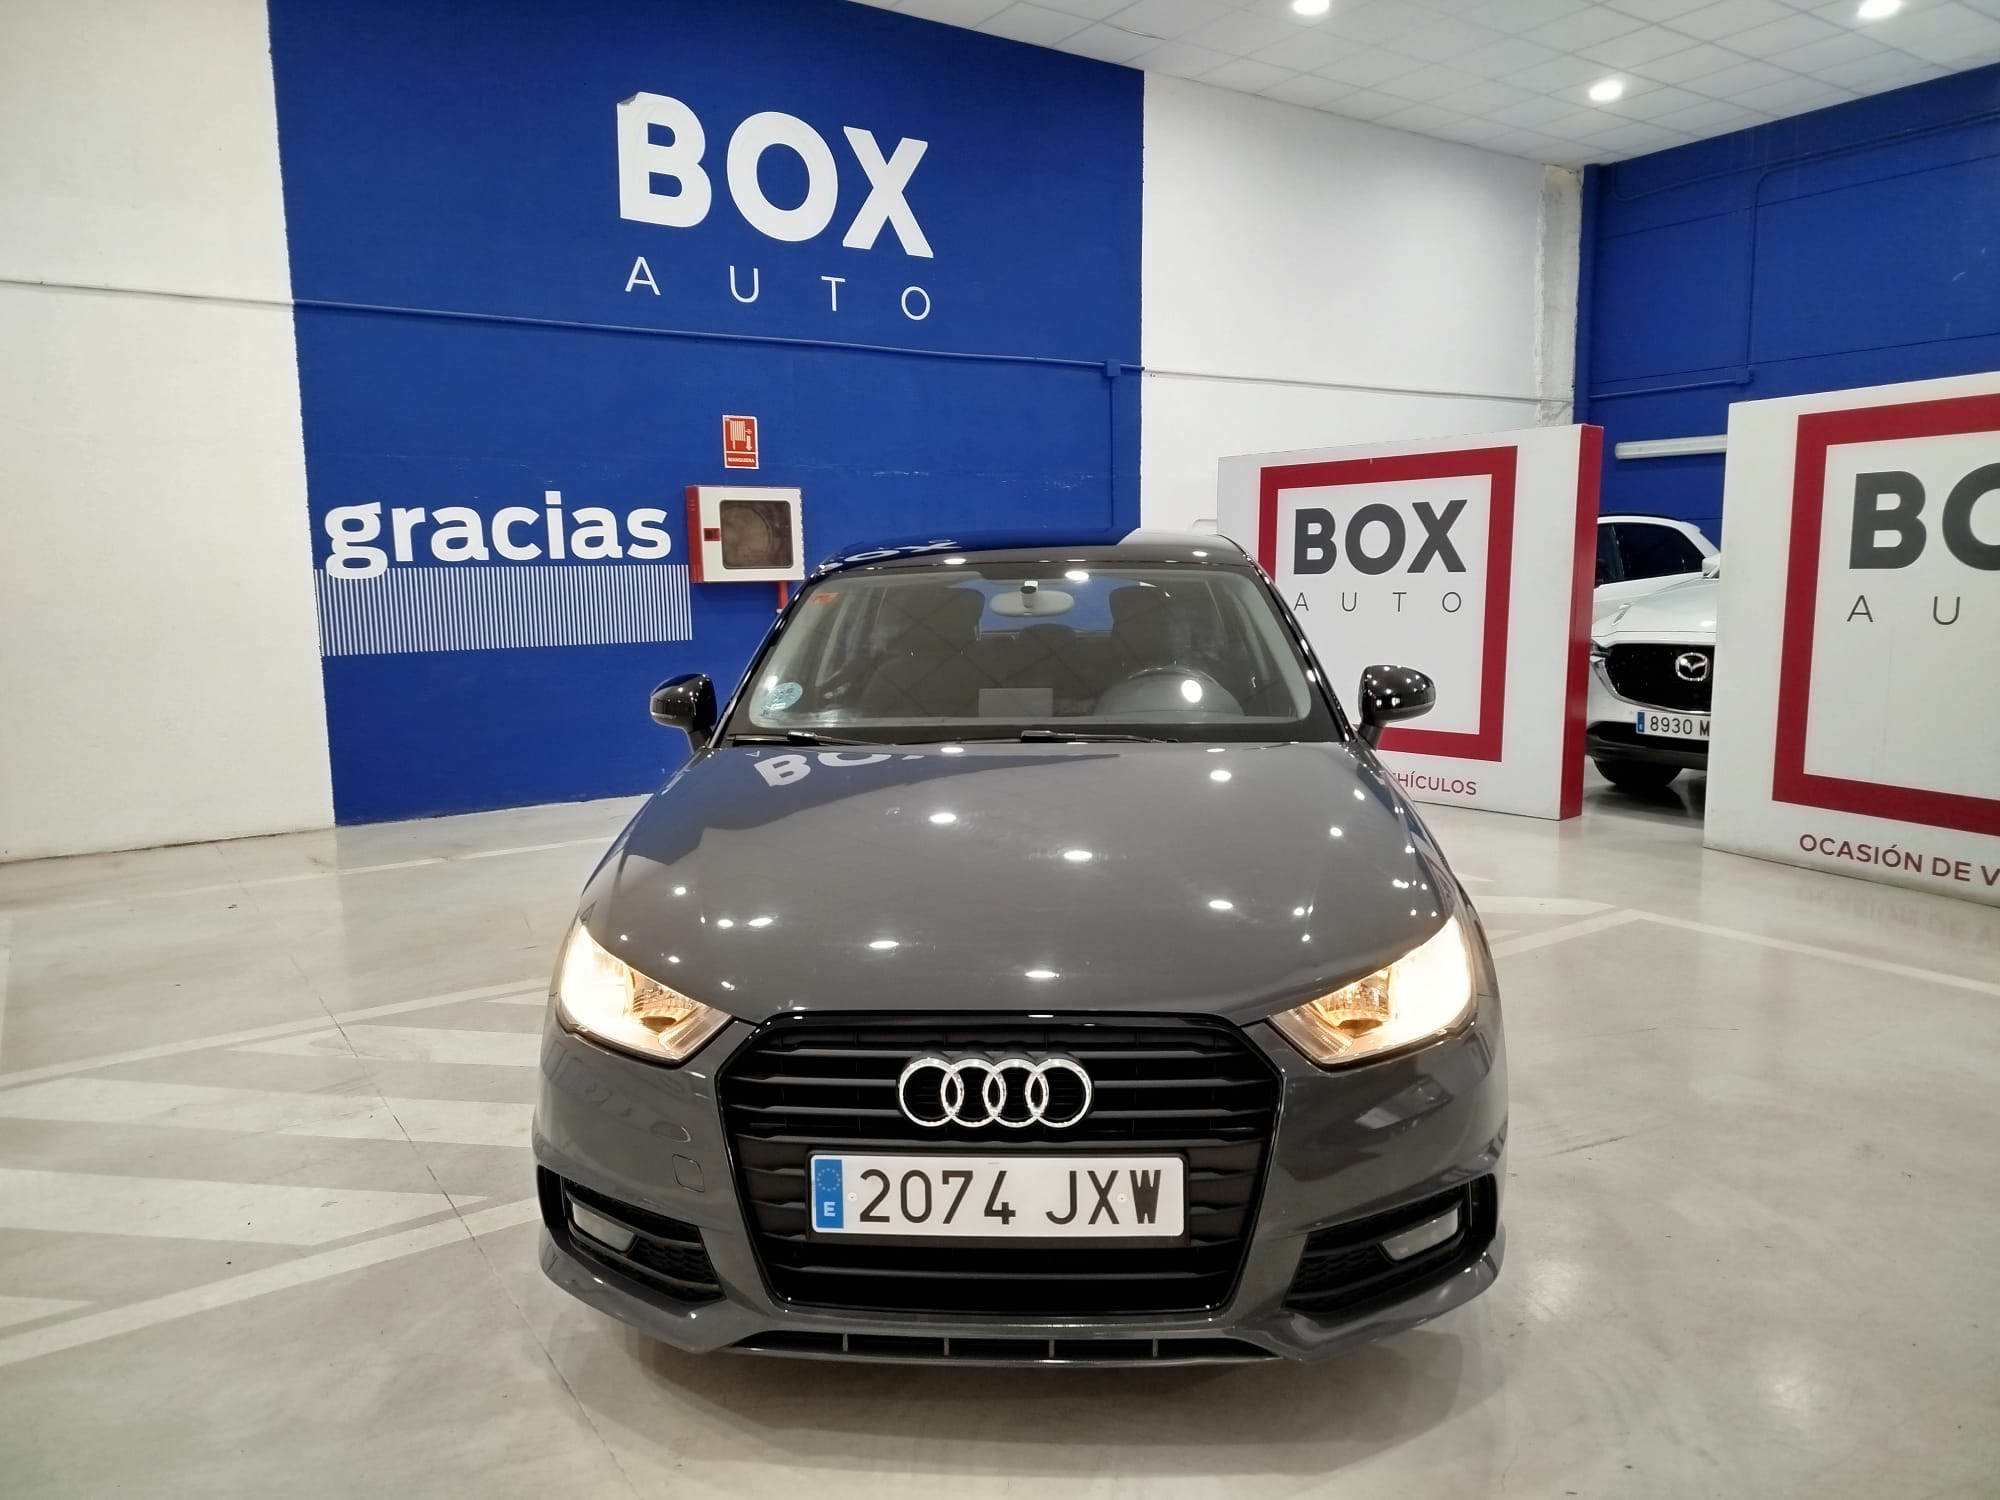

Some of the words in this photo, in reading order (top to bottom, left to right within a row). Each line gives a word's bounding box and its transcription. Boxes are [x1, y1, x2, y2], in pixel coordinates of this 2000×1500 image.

[617, 92, 933, 258] BOX
[625, 256, 931, 321] AUTO
[324, 490, 672, 580] gracias
[1294, 499, 1467, 575] BOX
[1294, 592, 1462, 613] AUTO
[1650, 716, 1692, 735] 8930
[1393, 770, 1477, 795] HÍCULOS
[1800, 834, 1923, 872] OCASIÓN
[1932, 857, 1971, 882] DE
[824, 1202, 836, 1217] E
[859, 1169, 1016, 1225] 2074
[1046, 1169, 1162, 1225] JXW
